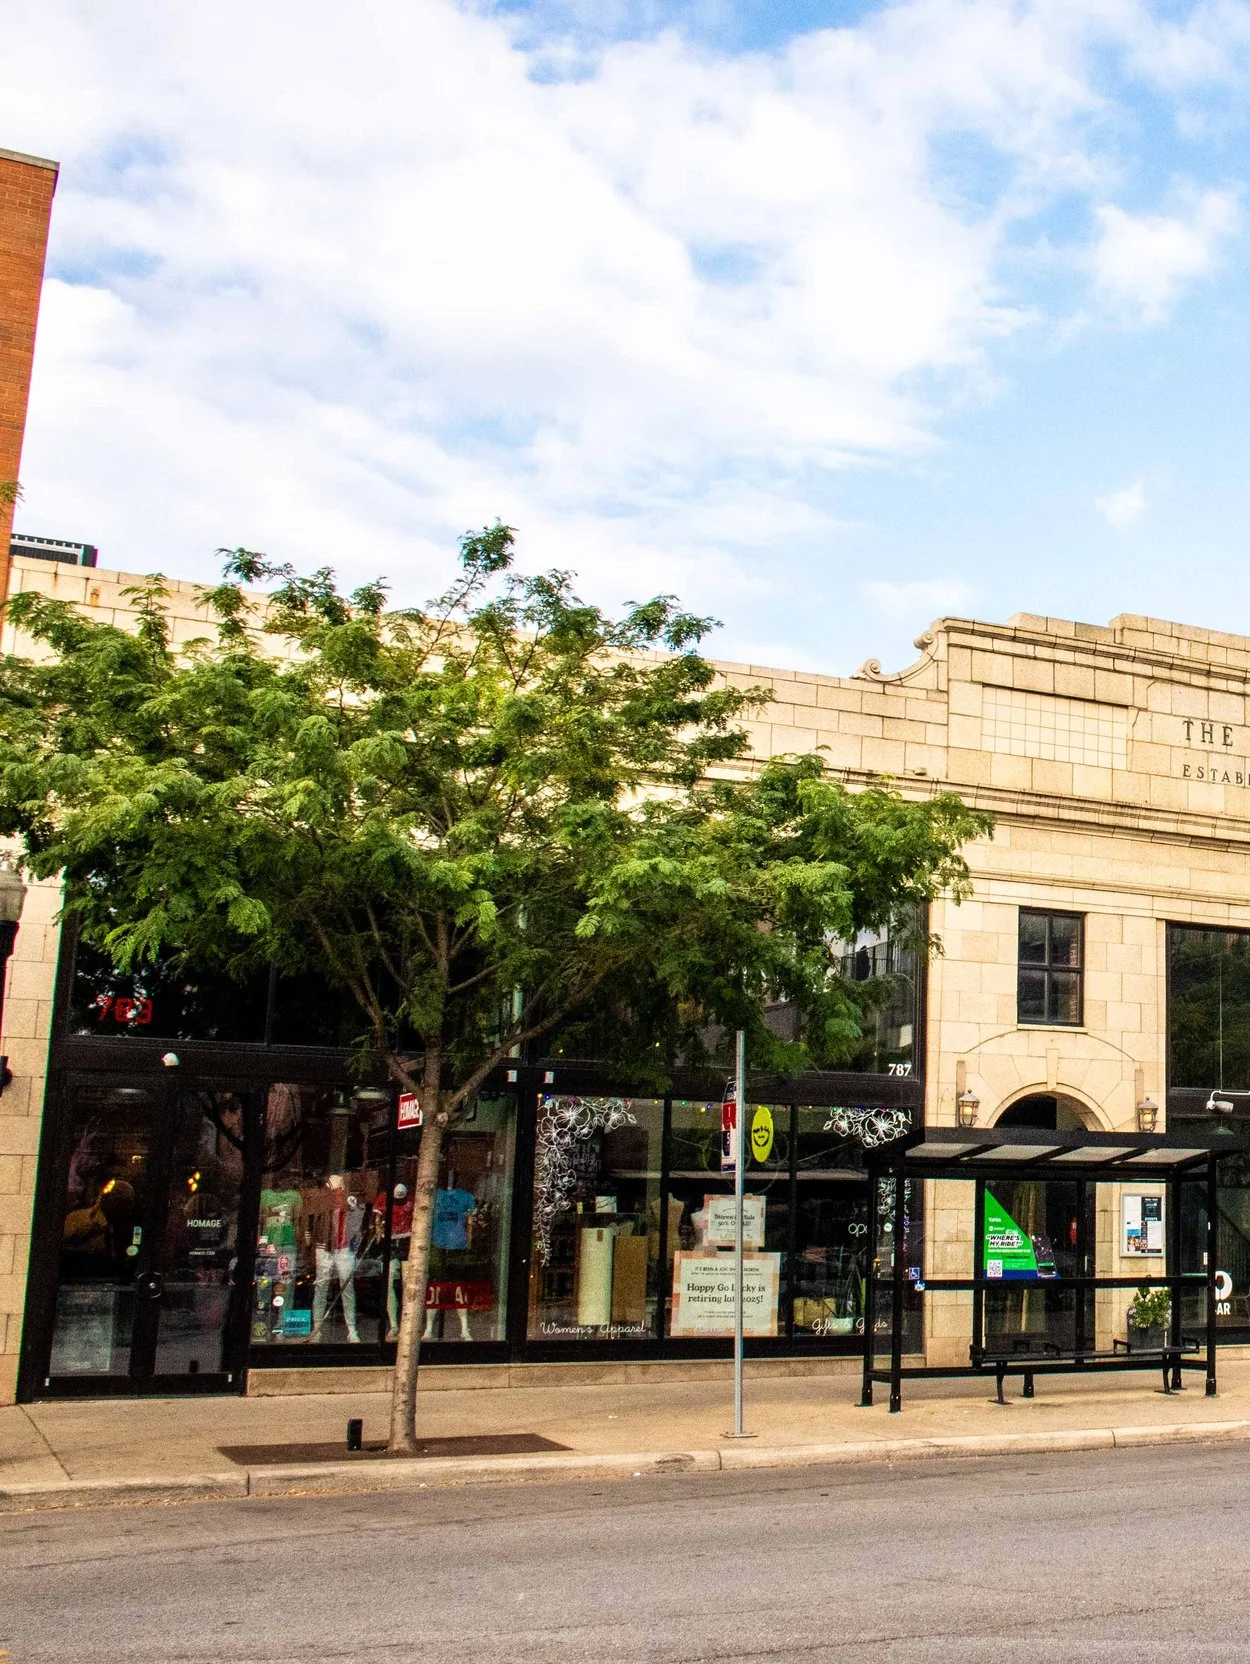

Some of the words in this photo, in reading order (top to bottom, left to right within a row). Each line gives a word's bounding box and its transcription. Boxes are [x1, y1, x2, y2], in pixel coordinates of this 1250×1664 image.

[1182, 718, 1234, 747] THE
[888, 1063, 912, 1076] 787
[186, 1219, 222, 1228] HOMAGE
[687, 1283, 716, 1294] Happy
[717, 1283, 729, 1292] Go
[731, 1283, 757, 1294] Lcky
[758, 1284, 766, 1292] is
[688, 1295, 722, 1305] retiring
[724, 1294, 736, 1303] lat
[1216, 1302, 1231, 1316] AR
[600, 1319, 647, 1340] Apparel
[856, 1317, 888, 1334] Gds
